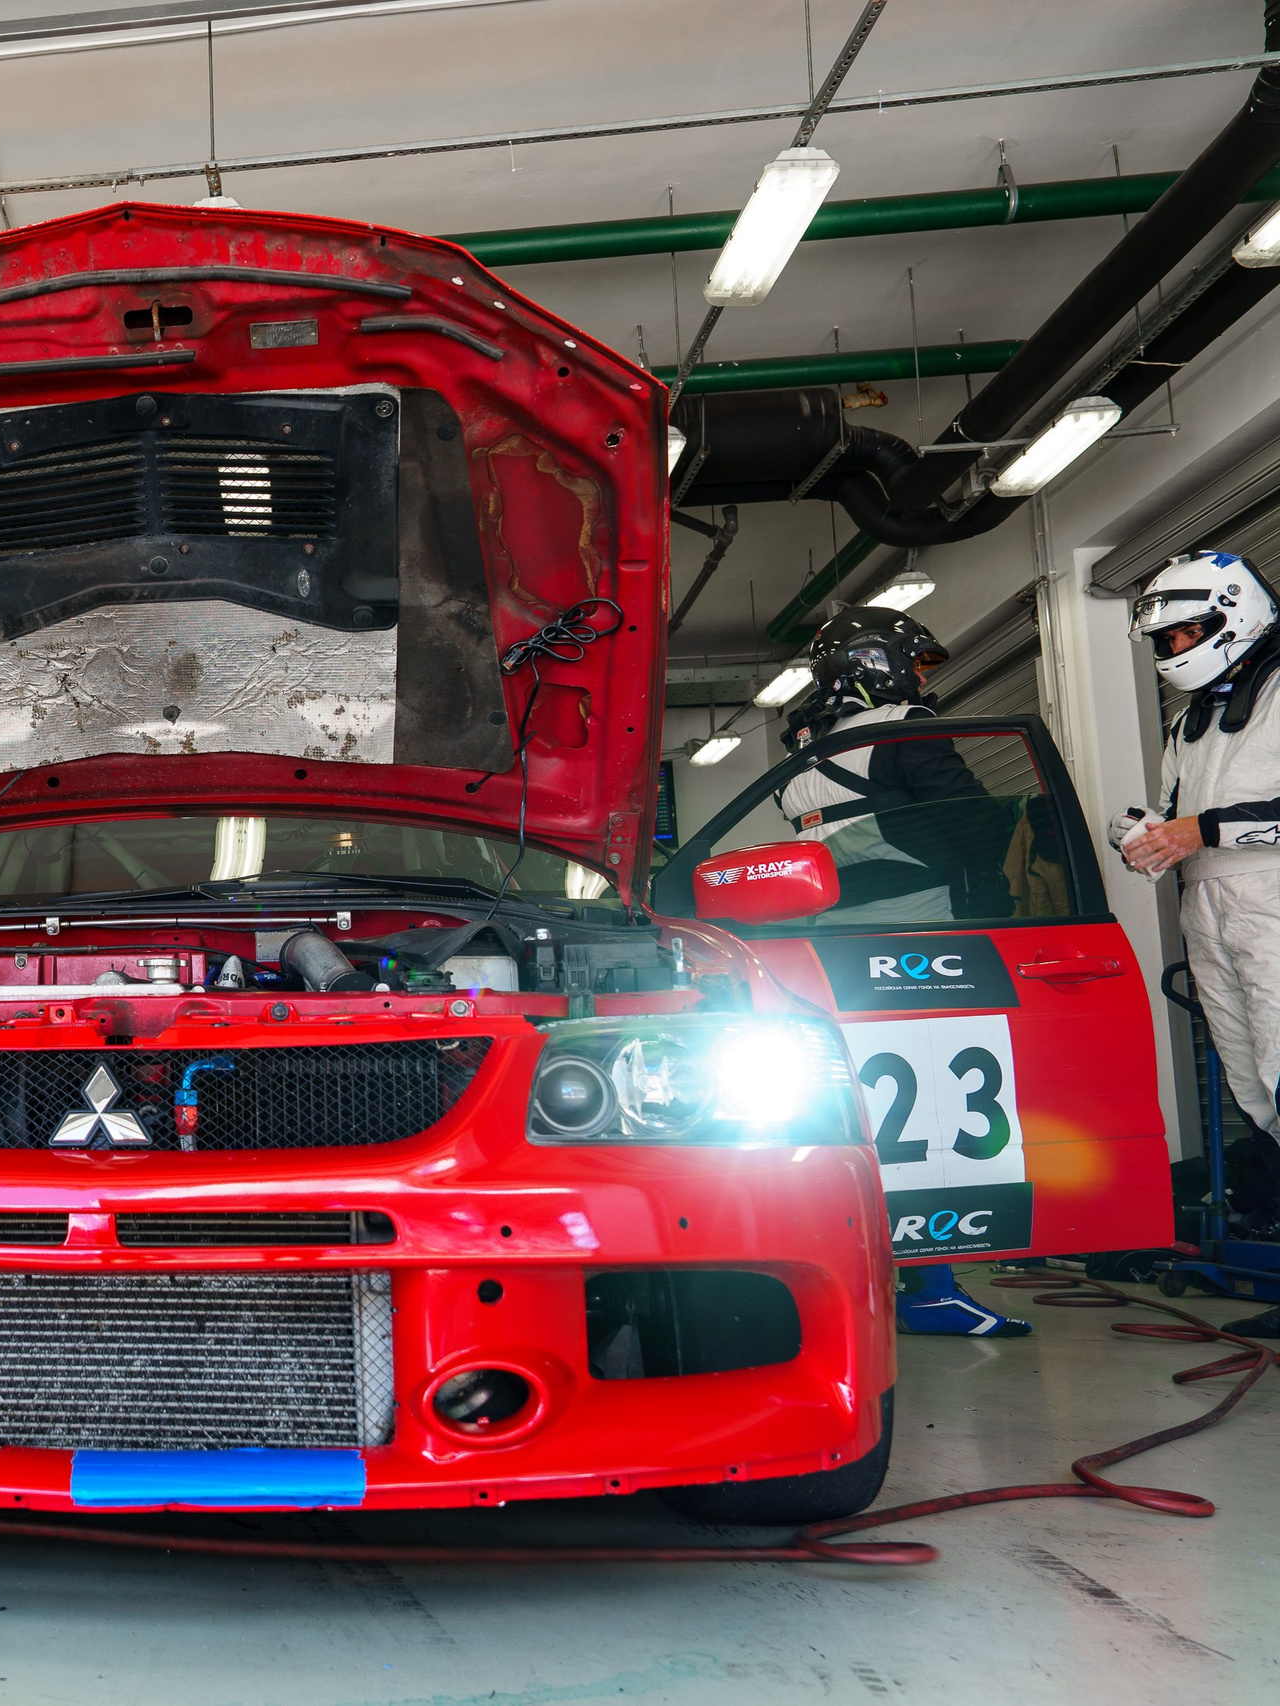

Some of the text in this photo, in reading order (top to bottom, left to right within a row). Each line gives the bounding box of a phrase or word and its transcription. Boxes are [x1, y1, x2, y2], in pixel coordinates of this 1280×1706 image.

[746, 860, 792, 876] X-RAYS
[746, 869, 793, 881] MOTORSPORT
[859, 1046, 1011, 1165] 23
